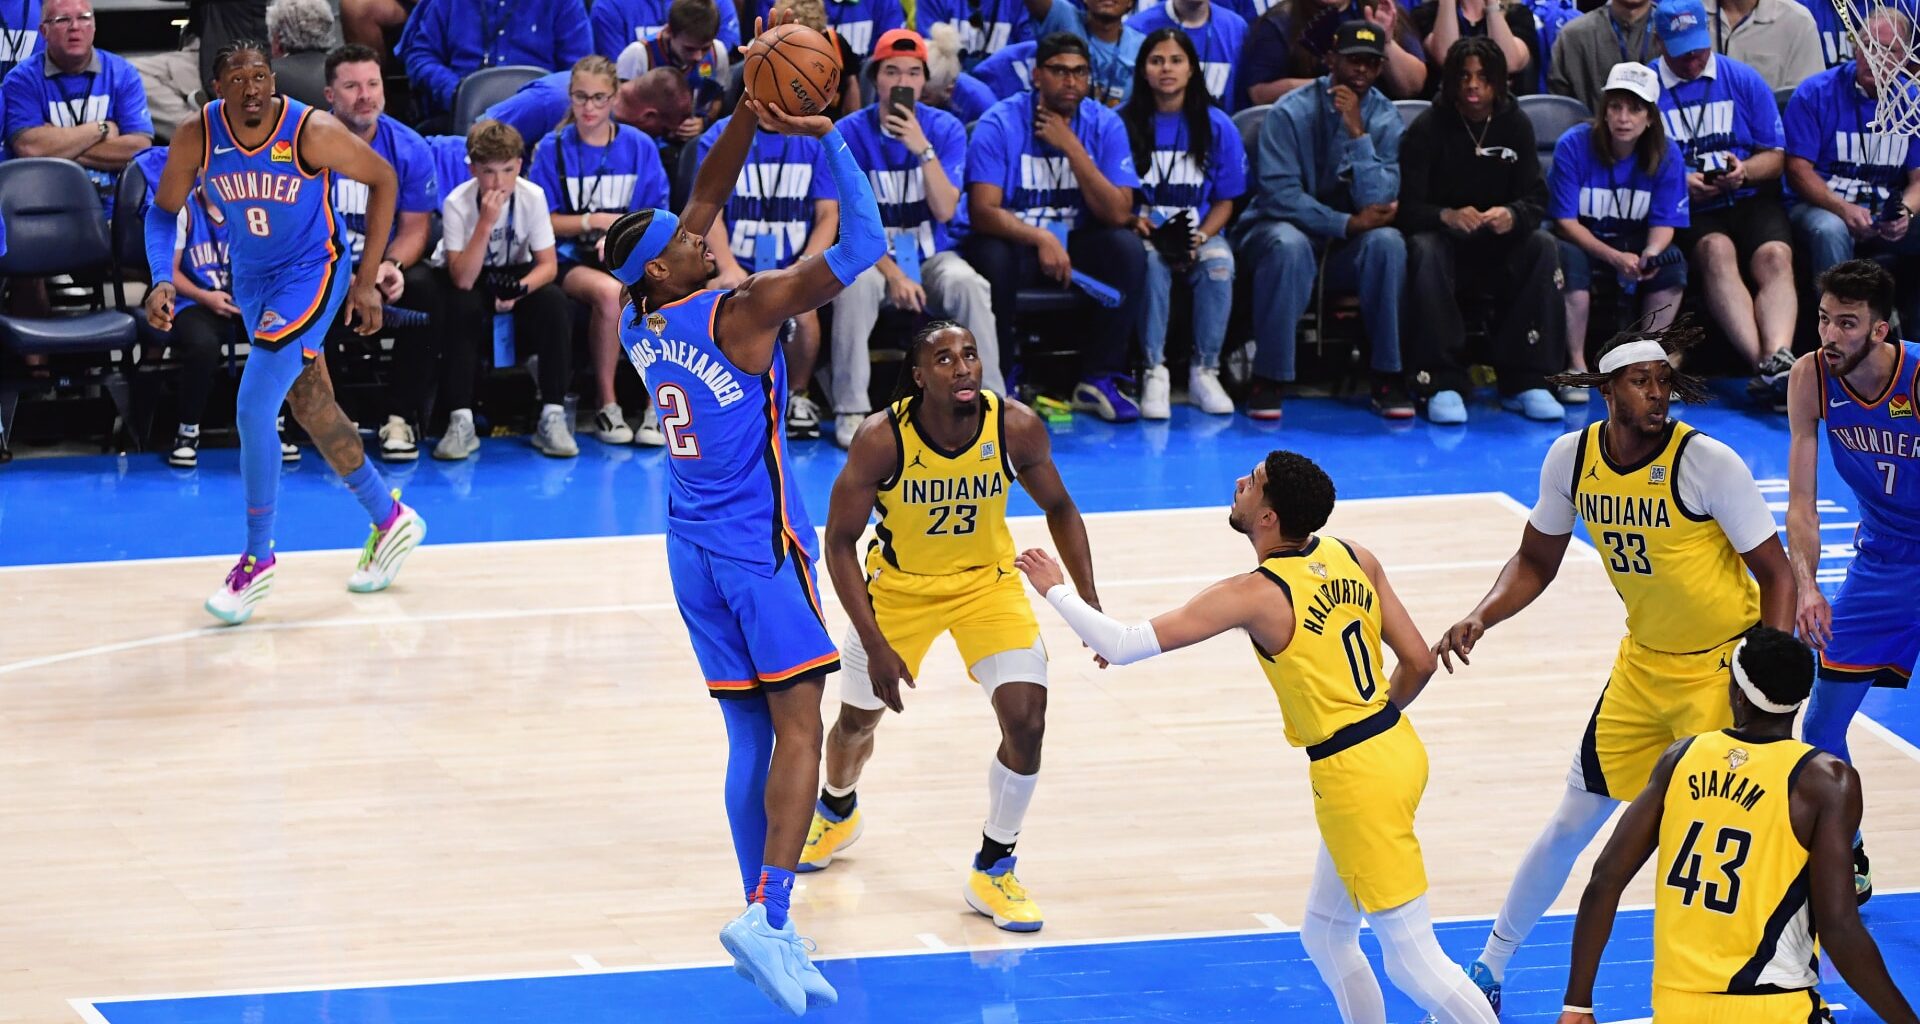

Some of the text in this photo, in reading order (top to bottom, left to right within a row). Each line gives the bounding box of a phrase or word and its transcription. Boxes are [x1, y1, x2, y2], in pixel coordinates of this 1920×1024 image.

[210, 172, 301, 203] THUNDER
[245, 206, 271, 237] 8
[656, 382, 701, 459] 2
[1830, 426, 1920, 458] THUNDER
[903, 471, 1003, 504] INDIANA
[1876, 461, 1896, 495] 7
[926, 504, 978, 536] 23
[1579, 492, 1671, 528] INDIANA
[1602, 531, 1653, 575] 33
[1341, 619, 1376, 702] 0
[1688, 770, 1766, 812] SIAKAM
[1666, 820, 1752, 915] 43
